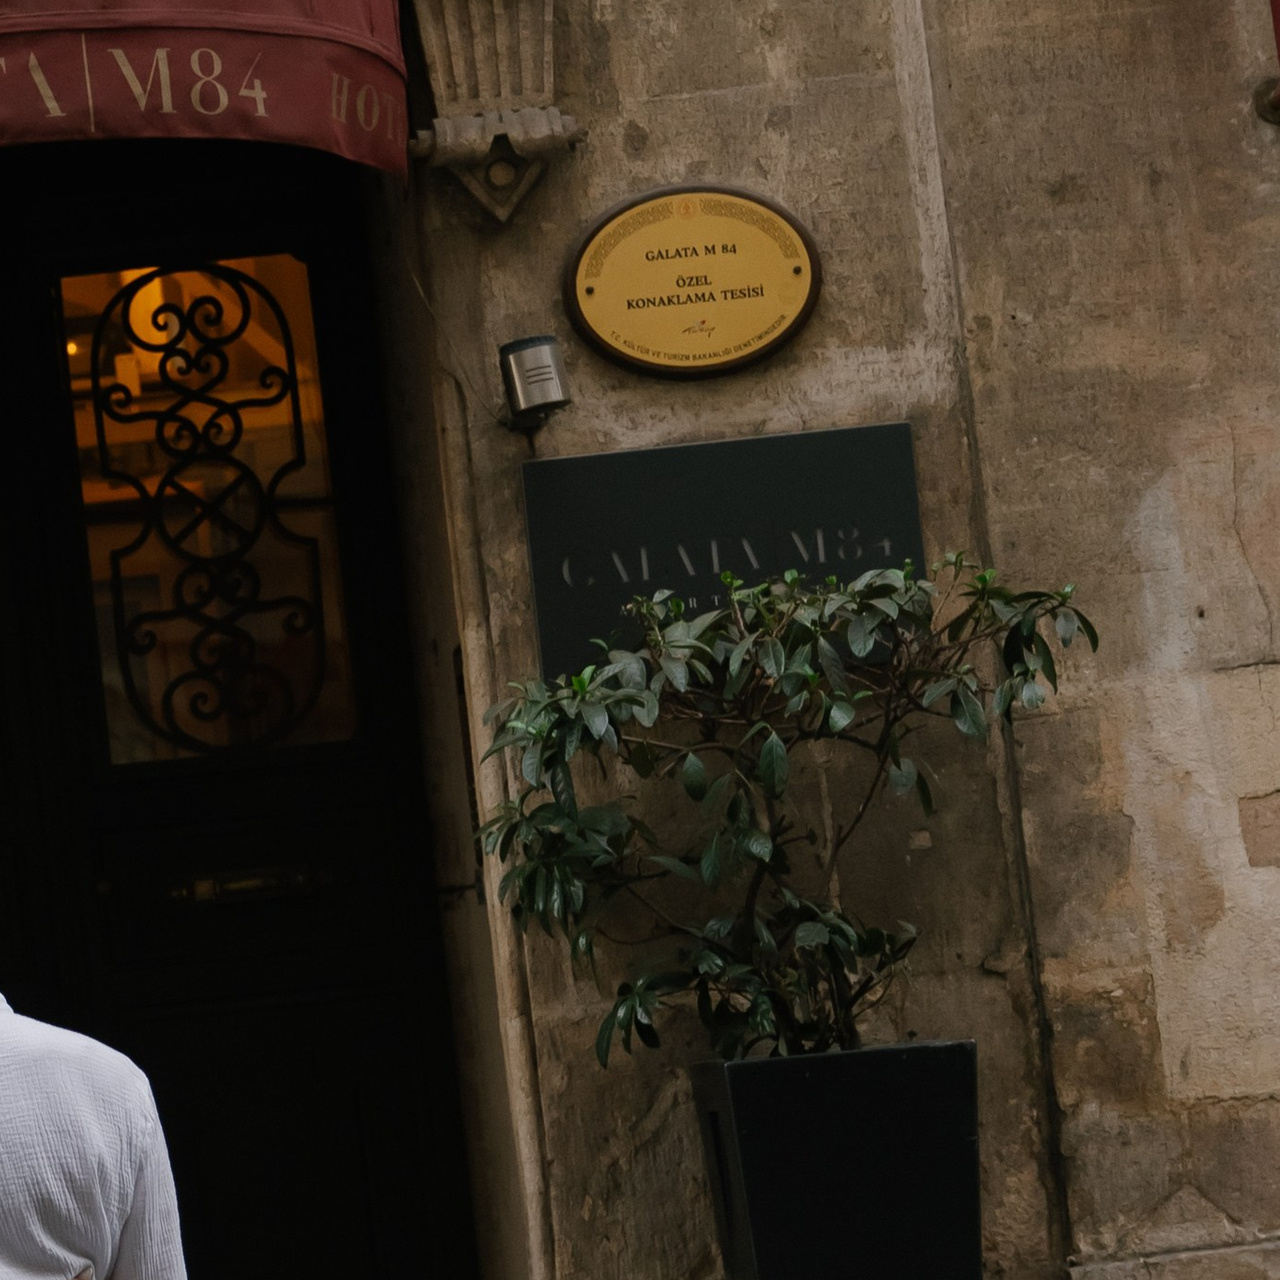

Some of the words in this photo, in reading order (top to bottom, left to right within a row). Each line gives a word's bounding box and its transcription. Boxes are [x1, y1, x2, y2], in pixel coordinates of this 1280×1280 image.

[107, 46, 269, 118] M84
[645, 246, 700, 262] GALATA
[704, 243, 716, 256] M
[721, 243, 737, 257] 84
[676, 274, 712, 289] ÖZEL
[626, 292, 717, 310] KONAKLAMA
[721, 283, 765, 301] TESİSİ
